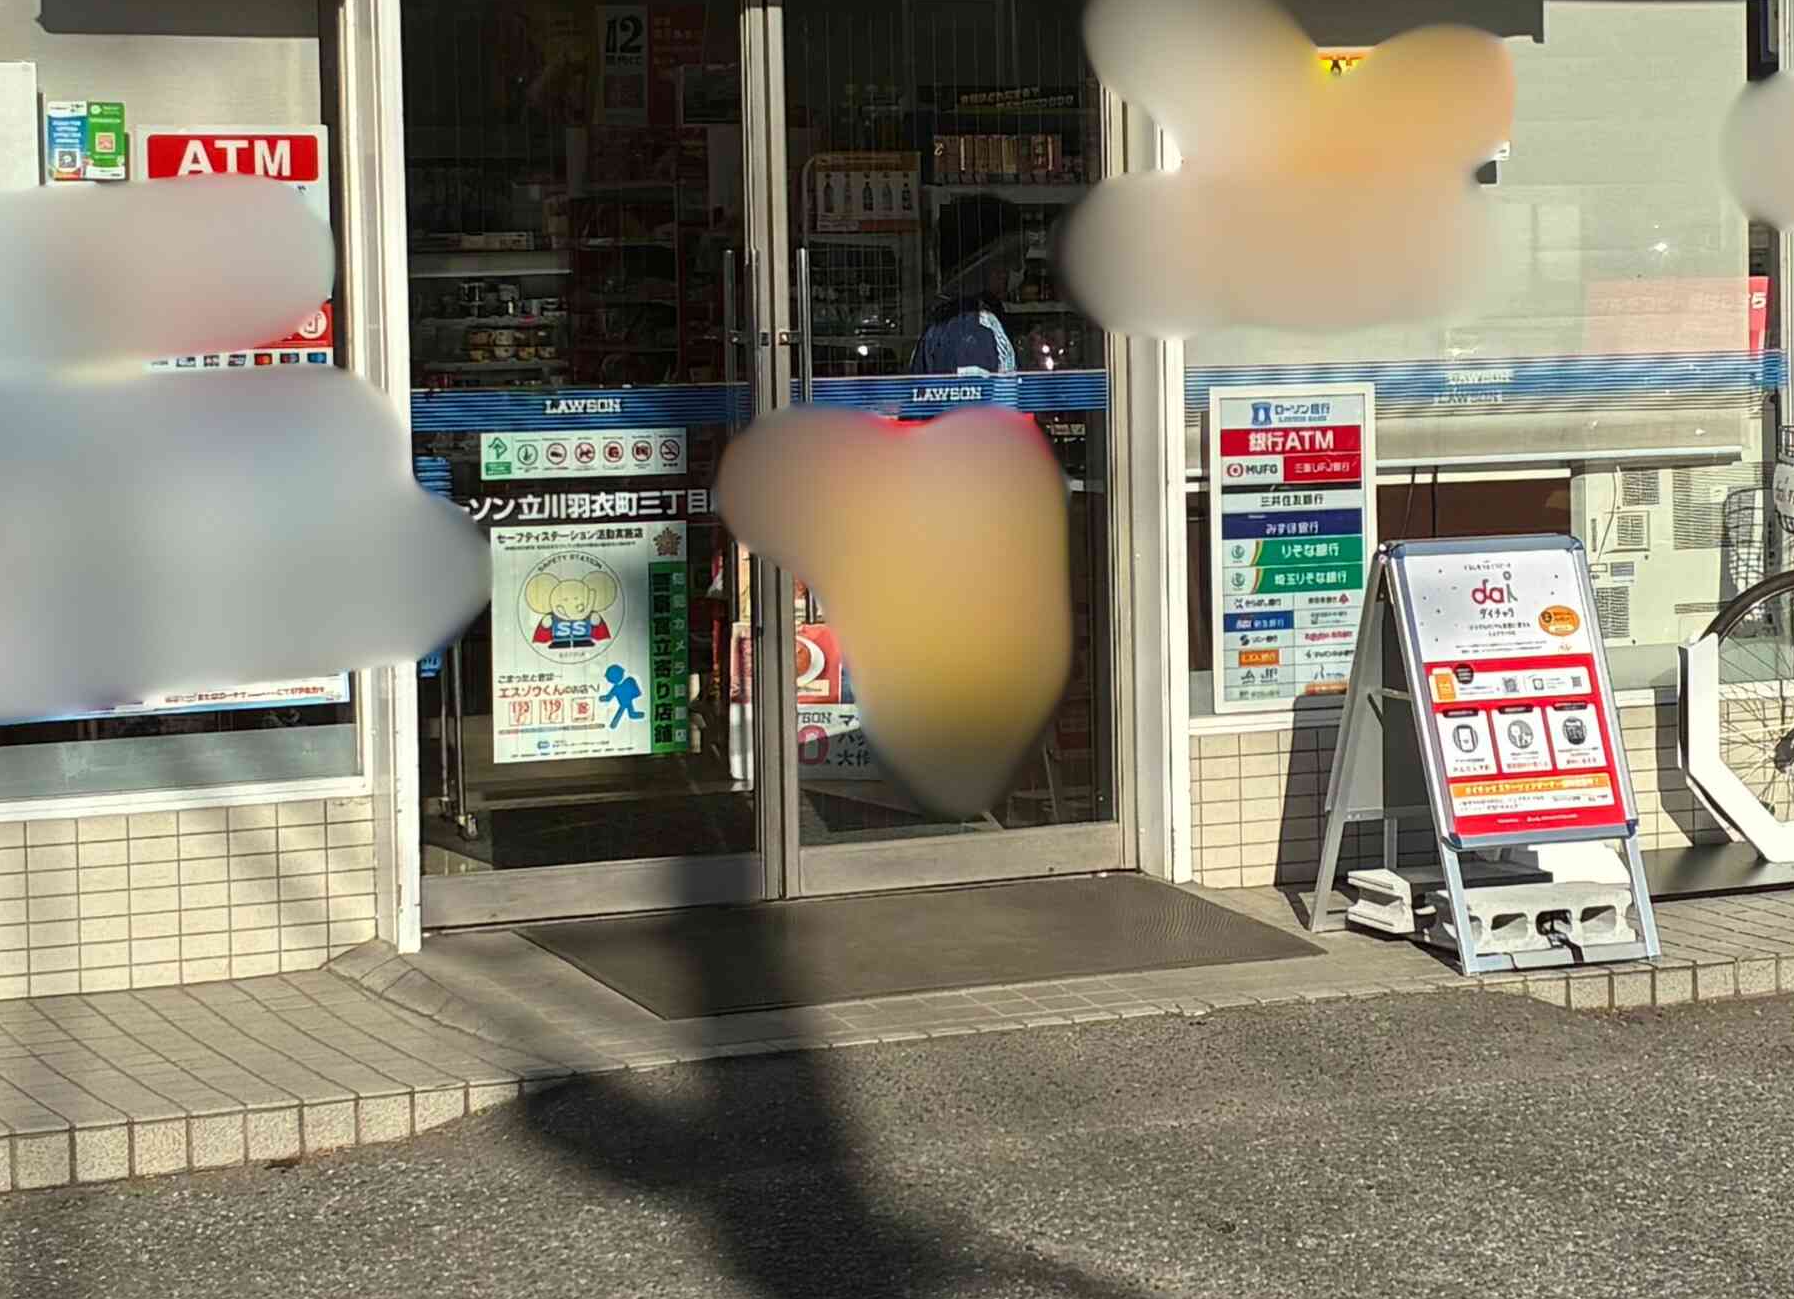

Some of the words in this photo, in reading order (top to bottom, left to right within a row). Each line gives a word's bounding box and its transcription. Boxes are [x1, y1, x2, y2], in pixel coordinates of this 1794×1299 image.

[177, 139, 291, 177] ATM
[913, 386, 982, 402] LAWSON
[544, 398, 622, 414] LAWSON
[1274, 402, 1330, 416] ローソン銀行
[1248, 430, 1334, 452] 銀行ATM
[1246, 463, 1278, 475] MUFG
[461, 489, 717, 521] ソン立川羽衣町三丁目
[1261, 493, 1324, 507] 三井住友銀行
[1265, 521, 1319, 535] みずほ銀行
[1281, 543, 1340, 559] りそな銀行
[1274, 570, 1348, 586] 埼玉りそな銀行
[556, 621, 586, 637] SS
